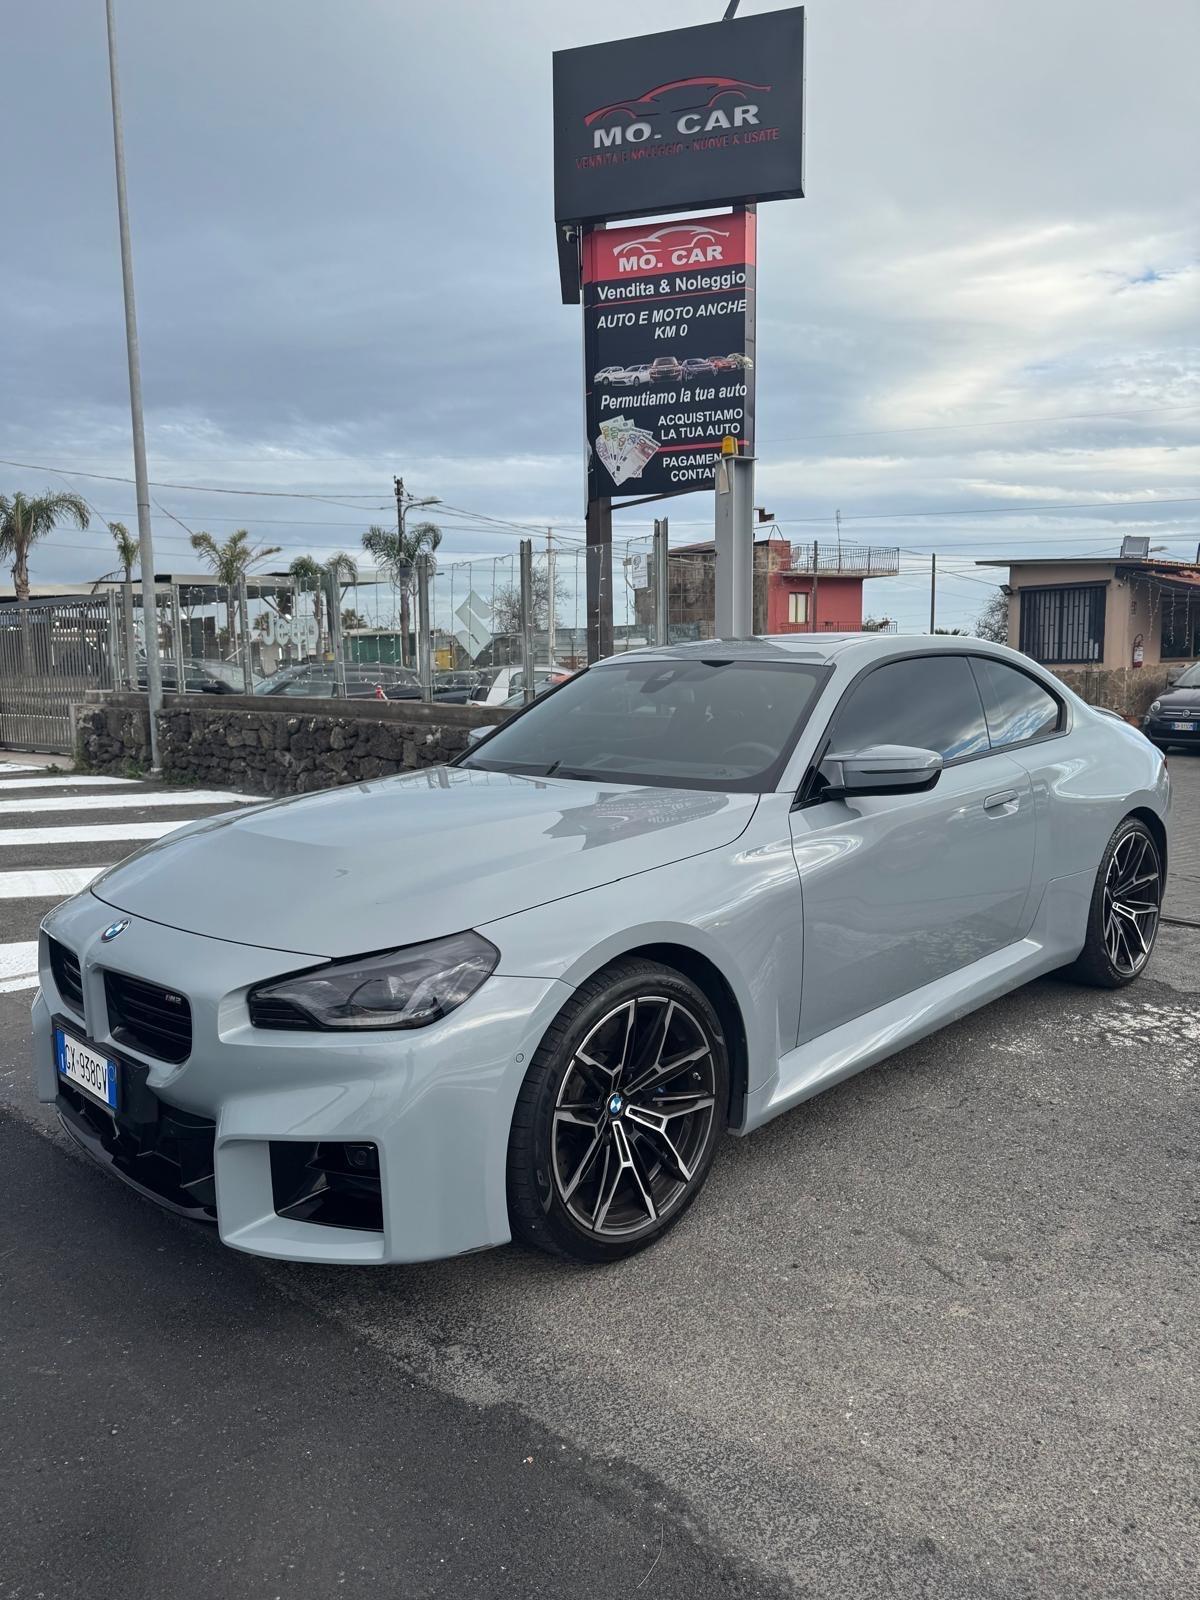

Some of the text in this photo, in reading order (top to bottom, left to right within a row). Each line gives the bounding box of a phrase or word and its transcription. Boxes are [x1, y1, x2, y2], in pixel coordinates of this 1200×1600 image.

[593, 104, 760, 148] MO. CAR
[693, 135, 728, 151] NUOVE
[732, 133, 740, 146] &
[744, 127, 780, 144] USATE
[618, 245, 723, 273] MO. CAR
[597, 271, 746, 301] Vendita & Noleggio
[597, 300, 747, 330] AUTO E MOTO ANCHE
[654, 324, 688, 340] KM 0
[600, 383, 747, 411] Permutiamo la tua auto
[657, 408, 743, 427] ACQUISTIAMO
[661, 423, 740, 440] LA TUA AUTO
